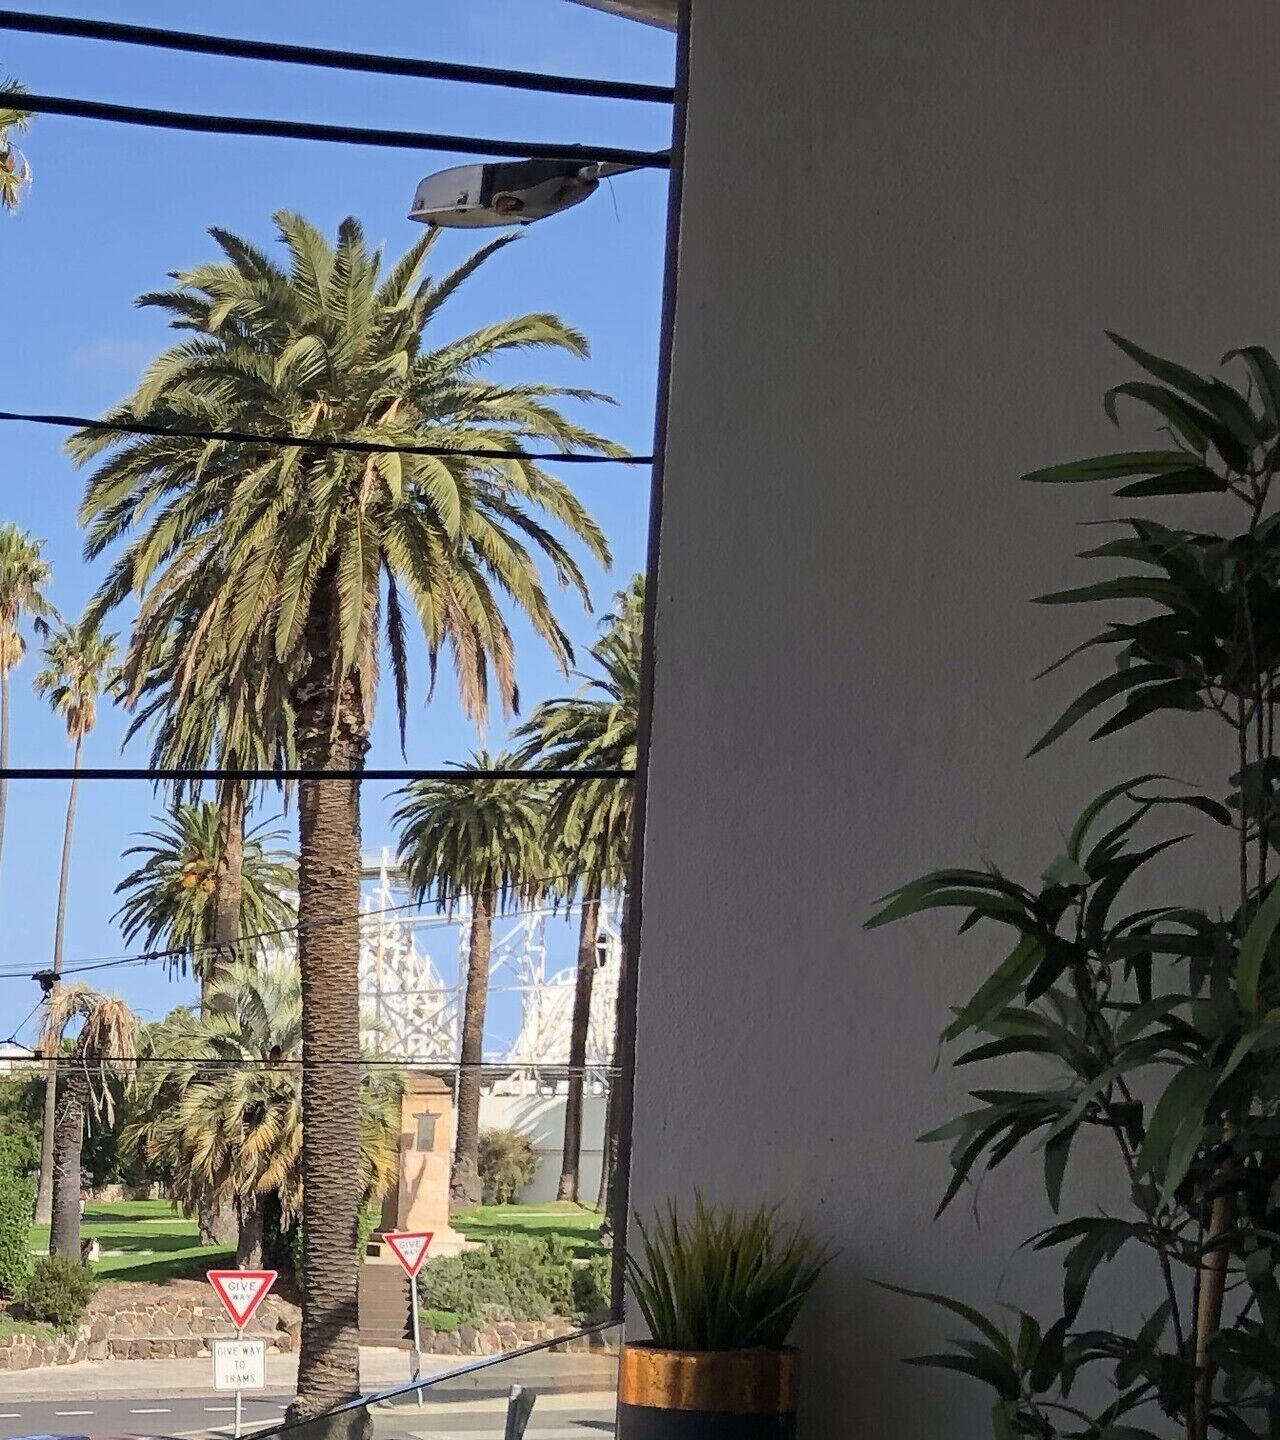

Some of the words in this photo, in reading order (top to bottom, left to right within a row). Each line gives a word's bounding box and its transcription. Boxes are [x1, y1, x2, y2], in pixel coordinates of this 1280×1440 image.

[228, 1281, 257, 1291] GIVE
[217, 1347, 239, 1356] GIVE
[242, 1346, 262, 1355] WAY
[234, 1360, 246, 1370] TO
[225, 1374, 256, 1384] TRAMS
